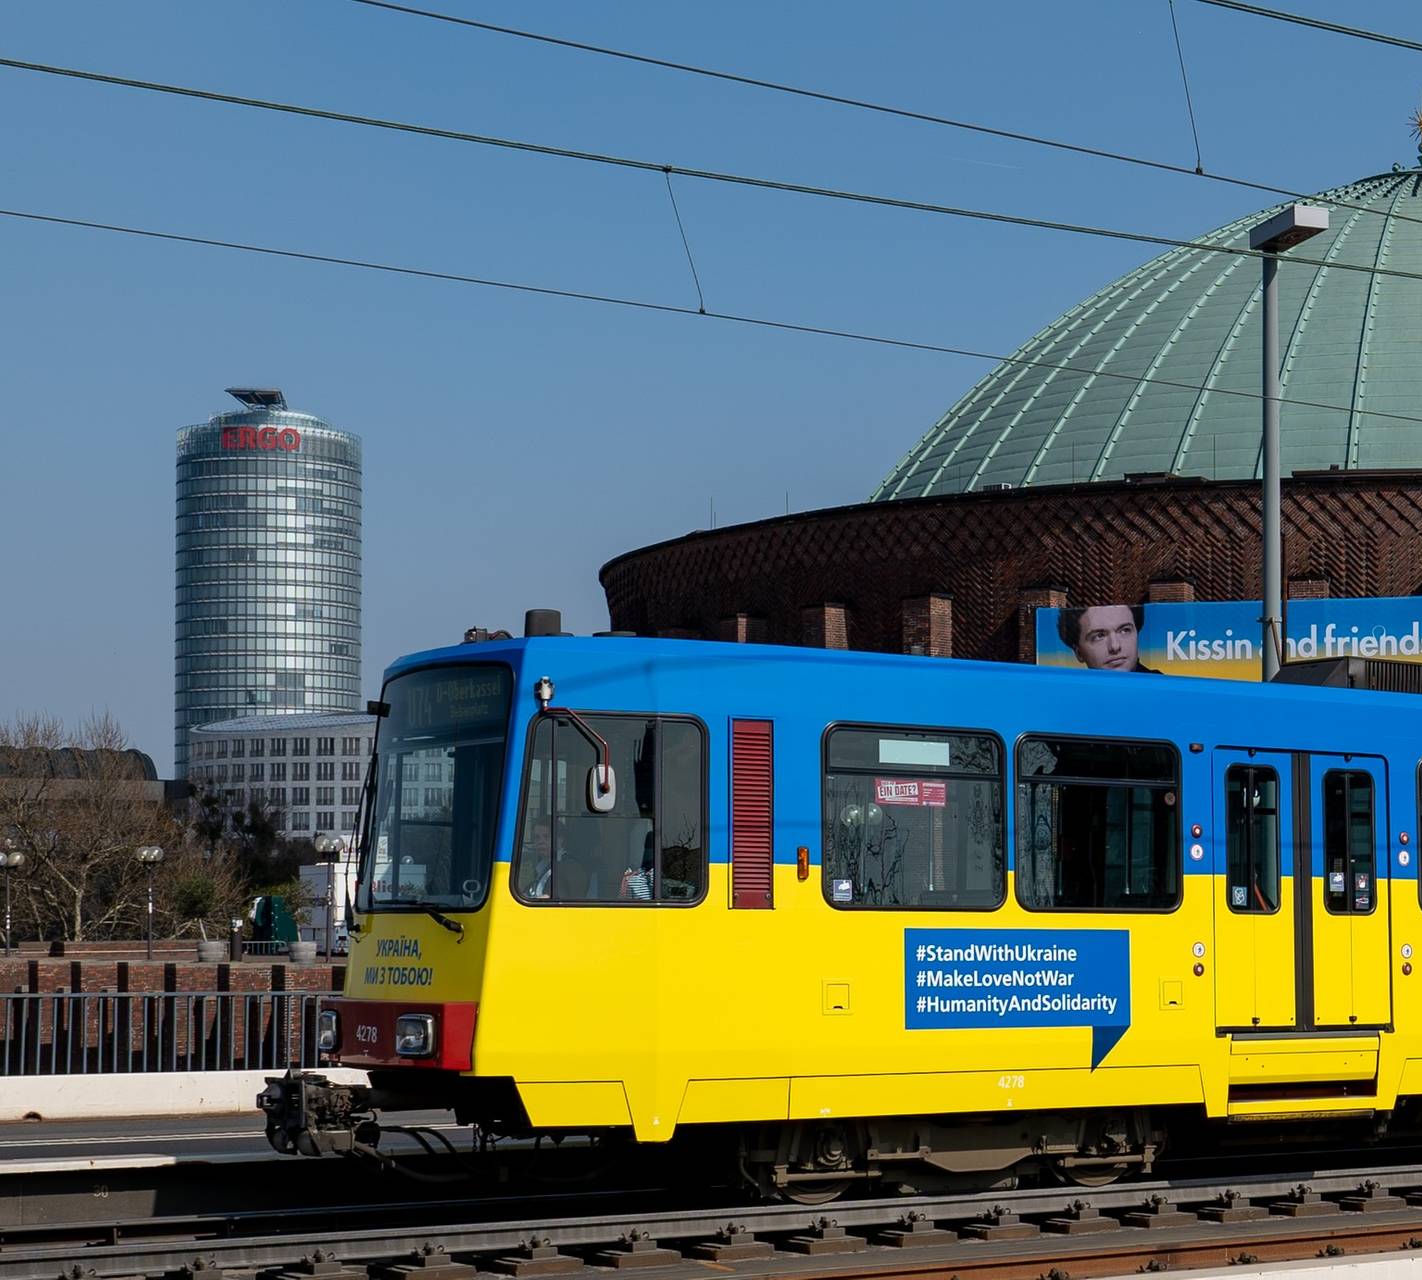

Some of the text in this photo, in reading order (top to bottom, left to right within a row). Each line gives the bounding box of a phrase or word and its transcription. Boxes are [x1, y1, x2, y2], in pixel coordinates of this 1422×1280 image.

[223, 426, 301, 451] ERGO
[1167, 629, 1251, 661] Kissin
[1258, 623, 1318, 658] nd
[879, 785, 893, 797] EIN
[894, 784, 917, 796] DATE?
[376, 935, 423, 960] УКРАЇНА,
[916, 944, 1078, 962] #StandWithUkraine
[364, 966, 379, 985] МИ
[388, 967, 434, 986] ТОБОЮ!
[916, 969, 1075, 987] #MakeLoveNotWar
[916, 993, 1118, 1017] #HumanityAndSolidarity
[356, 1023, 378, 1043] 4278
[998, 1075, 1025, 1089] 4278
